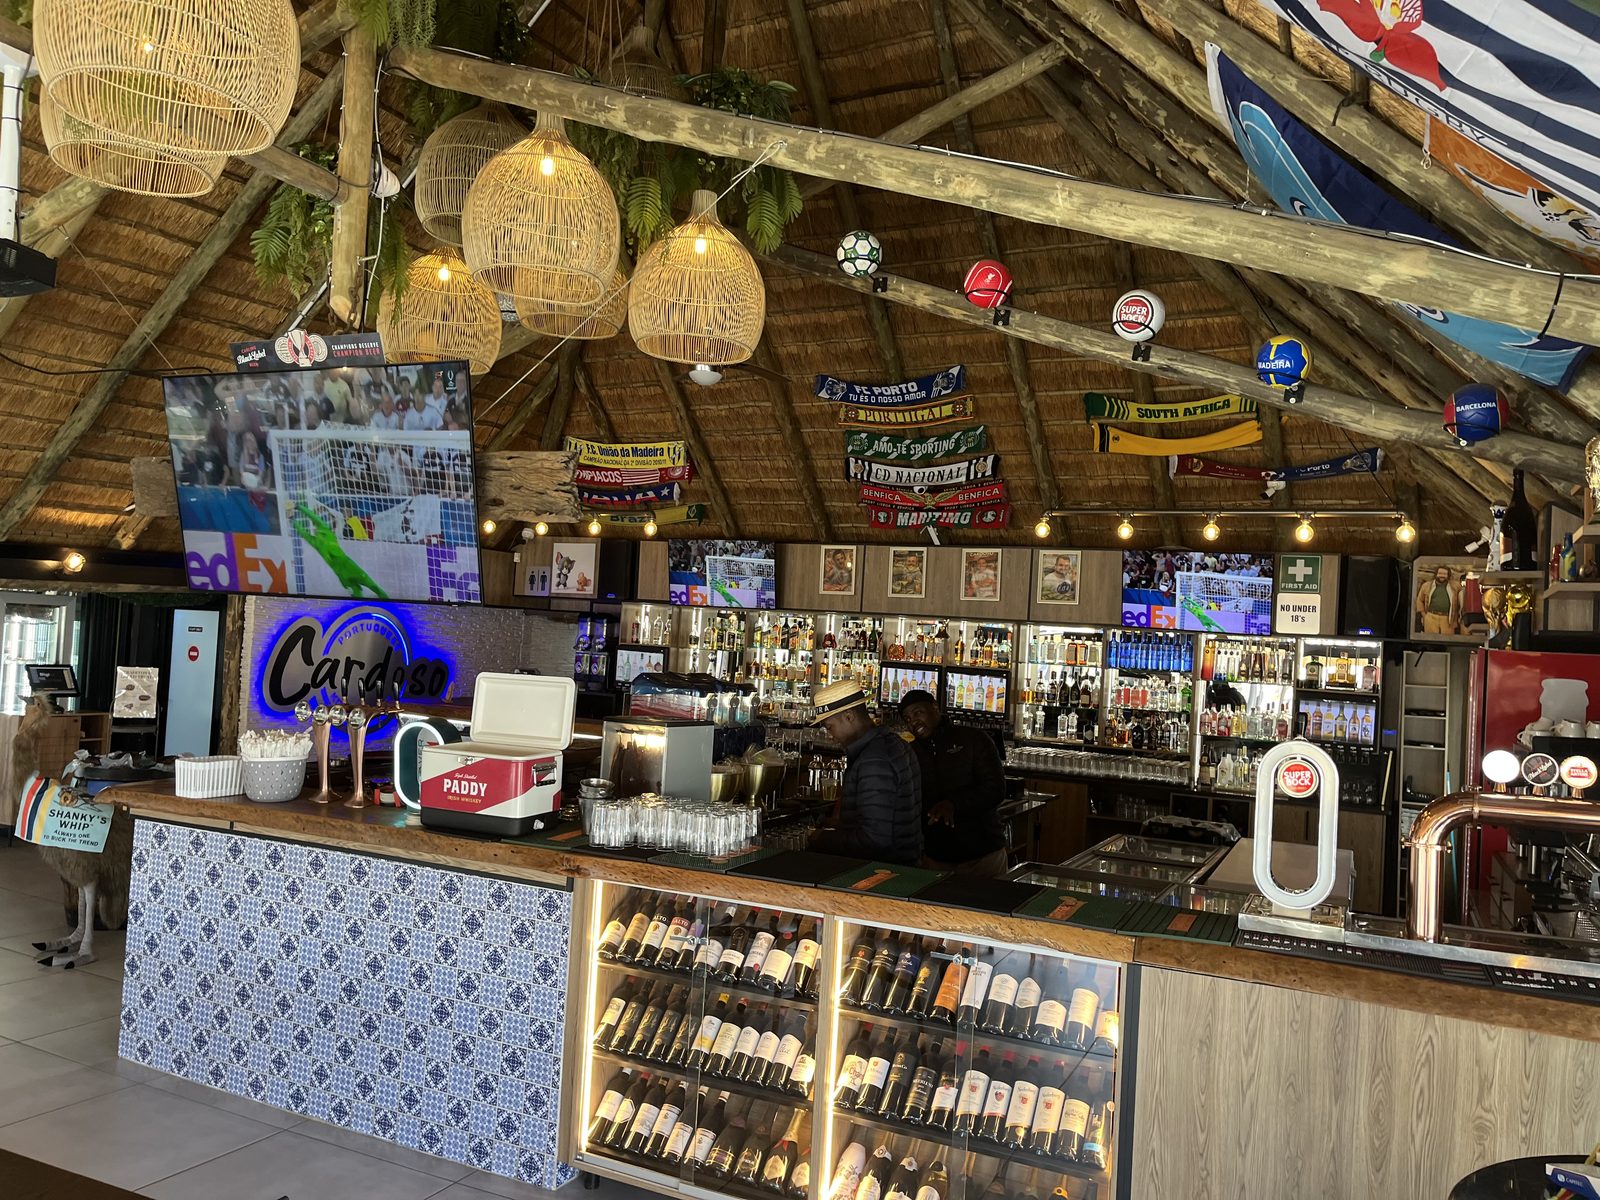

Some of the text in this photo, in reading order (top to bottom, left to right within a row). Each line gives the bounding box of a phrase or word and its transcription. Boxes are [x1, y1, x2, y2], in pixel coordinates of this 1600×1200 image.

[1363, 63, 1486, 142] RUGBY
[1121, 305, 1147, 316] SUPER
[1257, 359, 1292, 370] MADEIRA
[853, 381, 918, 396] FC PORTO
[848, 390, 927, 403] TU ÉS O NOSSO AMOR
[1136, 398, 1231, 419] SOUTH AFRICA
[1455, 401, 1497, 413] BARCELONA
[863, 406, 944, 423] PORTUGAL
[586, 444, 665, 457] F.C. União da Madeira
[872, 438, 956, 455] AMO-TE SPORTING
[602, 458, 623, 466] NACIONAL
[874, 466, 965, 483] CD NACIONAL
[863, 488, 901, 502] BENFICA
[958, 487, 1000, 501] BENFICA
[1280, 604, 1317, 613] NO UNDER
[1290, 614, 1306, 623] 18's
[269, 624, 449, 706] Cardoso
[1283, 770, 1312, 779] SUPER
[443, 778, 488, 797] PADDY
[1286, 778, 1312, 786] BOCK
[48, 808, 107, 825] SHANKY'S
[59, 820, 90, 831] WHIP
[50, 835, 67, 843] BUCK
[53, 829, 77, 839] ALWAYS
[652, 914, 667, 922] ALTO
[674, 919, 689, 927] ALTO
